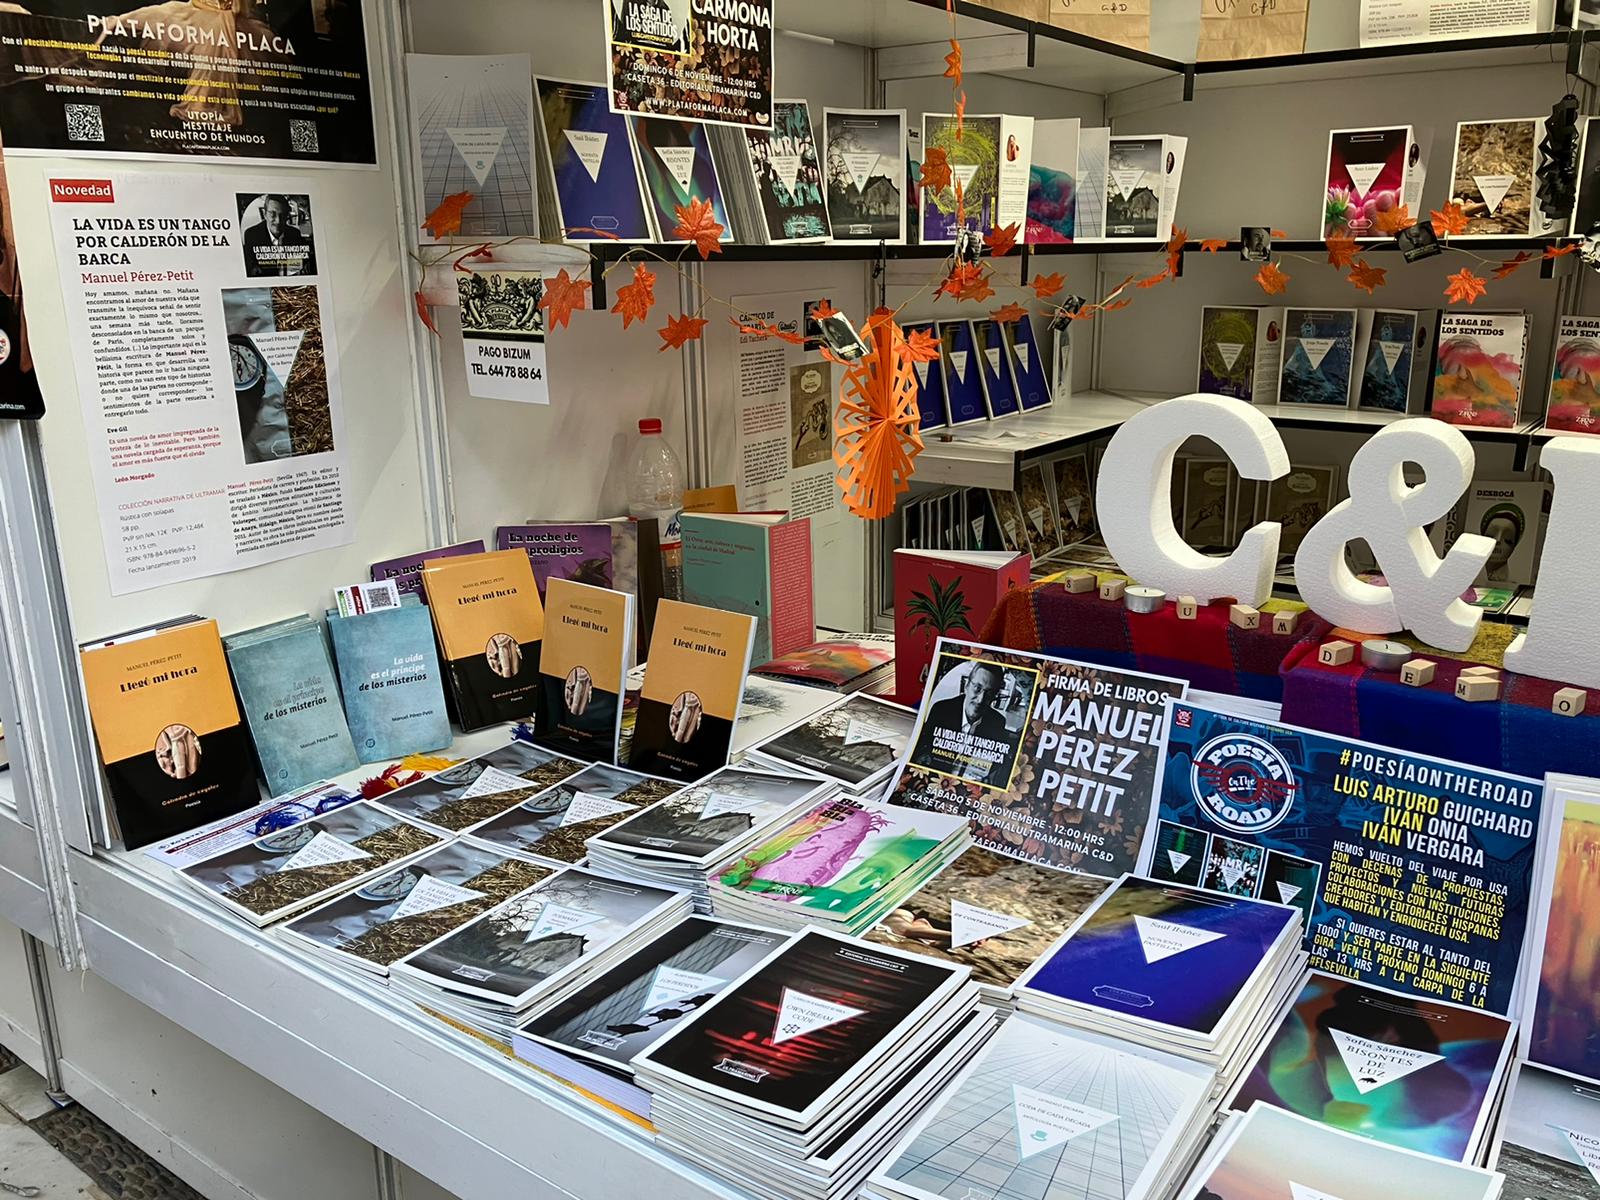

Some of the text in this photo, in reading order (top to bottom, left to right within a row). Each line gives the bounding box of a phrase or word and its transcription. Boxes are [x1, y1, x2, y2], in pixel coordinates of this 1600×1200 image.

[628, 2, 672, 23] LA SAGA DE
[692, 0, 771, 29] CARMONA
[86, 14, 295, 55] PLATAFORMA PLACA
[625, 15, 641, 32] LOS
[641, 18, 678, 38] SENTIDOS
[706, 20, 759, 51] HORTA
[633, 62, 756, 88] DOMINGO 6 DE NOVIEMBRE 12:00 HRS
[627, 73, 761, 100] CASETA 36 EDITORIALULTRAMARINA C&D
[150, 128, 265, 143] ENCUENTRO DE MUNDOS
[182, 121, 231, 132] MESTIZAJE
[53, 184, 111, 195] Novedad
[72, 219, 230, 230] LA VIDA ES UN TANGO
[75, 233, 229, 247] POR CALDERÓN DE LA
[78, 253, 130, 265] BARCA
[81, 269, 194, 283] Manuel Pérez-Petit
[1459, 328, 1504, 336] SENTIDOS
[479, 346, 531, 360] PAGO BIZUM
[489, 365, 503, 376] 644
[505, 366, 516, 378] 78
[518, 367, 529, 379] 88
[530, 368, 542, 380] 64
[508, 532, 579, 544] La noche de
[1104, 588, 1110, 596] J
[1183, 607, 1192, 616] U
[1247, 617, 1255, 626] X
[1277, 622, 1287, 632] M
[394, 653, 423, 665] La vida
[120, 667, 197, 692] Llegó mi hora
[359, 673, 427, 691] de los misterios
[381, 669, 389, 677] el
[1322, 651, 1571, 711] D E M O
[1047, 673, 1168, 707] FIRMA DE LIBROS
[1035, 727, 1139, 781] PÉREZ
[1341, 748, 1532, 809] #POESÍAONTHEROAD
[1036, 768, 1125, 818] PETIT
[1207, 793, 1272, 823] ROAD
[1335, 774, 1533, 839] LUIS ARTURO GUICHARD
[909, 792, 1114, 862] CASETA 36 EDITORIALULTRAMARINA C&D
[964, 797, 971, 806] 5
[972, 800, 985, 810] DE
[987, 804, 1045, 828] NOVIEMBRE
[1053, 824, 1080, 839] 12:00
[1082, 832, 1104, 846] HRS
[1383, 802, 1469, 844] IVÁN ONIA
[1361, 817, 1485, 868] IVÁN VERGARA
[1331, 851, 1349, 864] CON
[1362, 859, 1402, 878] DECENAS
[1416, 873, 1428, 885] DE
[1333, 840, 1508, 895] HEMOS VUELTO DEL VIAJE POR USA
[1329, 861, 1504, 917] PROYECTOS Y NUEVAS FUTURAS
[1144, 940, 1181, 950] PASTILLAS
[1147, 936, 1183, 947] NOVENTA
[1309, 955, 1360, 979] #FLSEVILLA
[786, 1004, 804, 1014] OWN
[805, 1010, 834, 1021] DREAM
[792, 1014, 815, 1024] CODE
[1345, 1036, 1422, 1058] Sofía Sánchez
[1347, 1045, 1413, 1066] BISONTES
[1359, 1067, 1385, 1078] LUZ
[1367, 1060, 1385, 1068] DE
